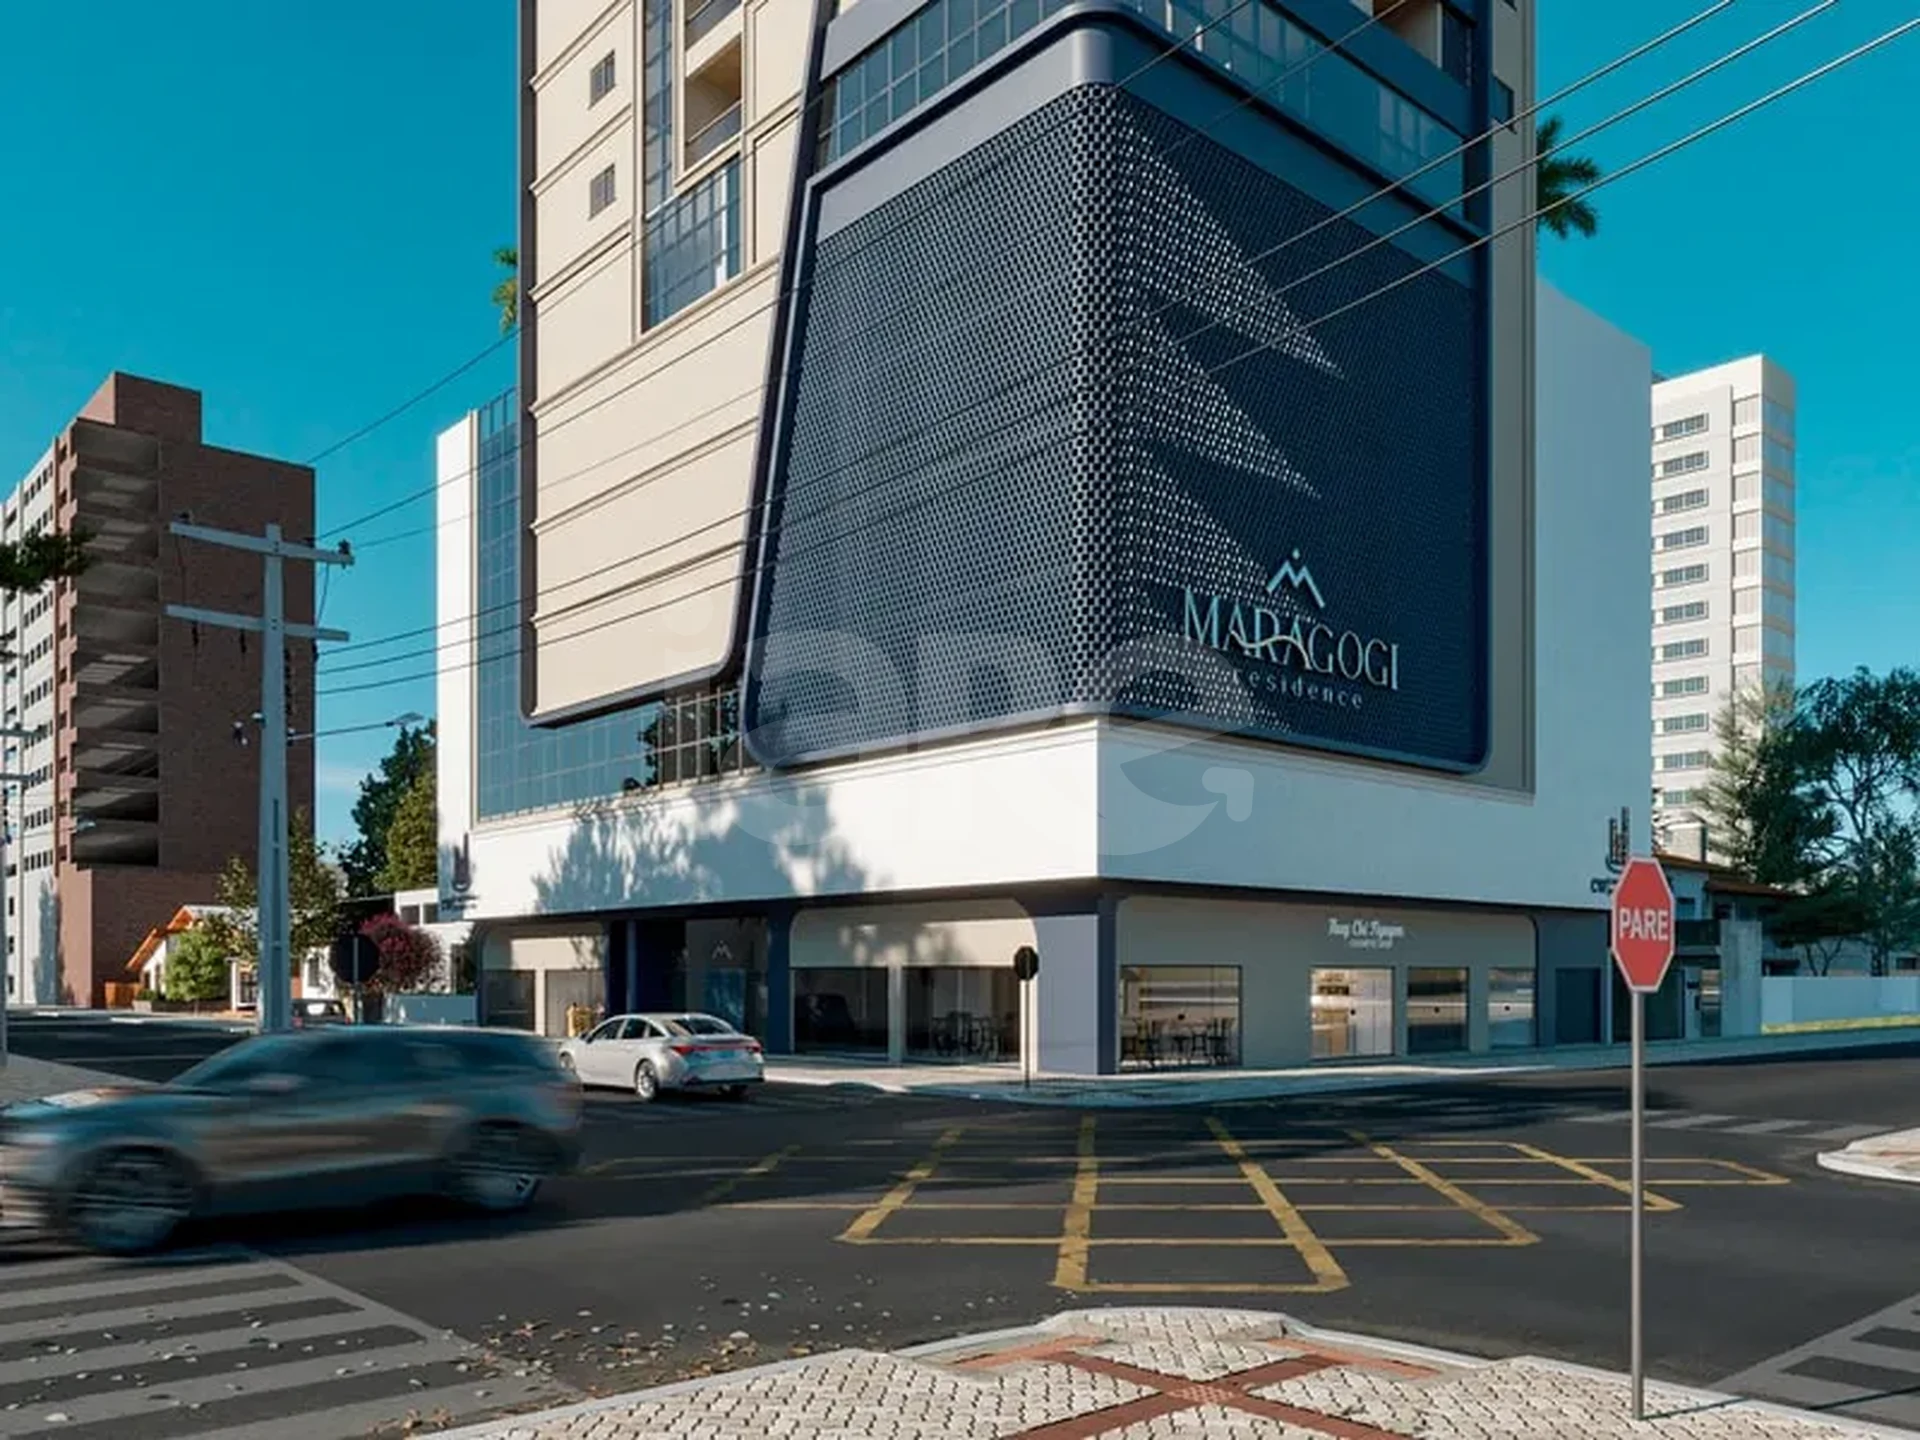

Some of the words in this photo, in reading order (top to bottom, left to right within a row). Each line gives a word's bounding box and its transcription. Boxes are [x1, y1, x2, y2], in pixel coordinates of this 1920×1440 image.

[1184, 586, 1399, 690] MARAGOGI
[1232, 668, 1363, 709] residence
[1618, 907, 1669, 941] PARE
